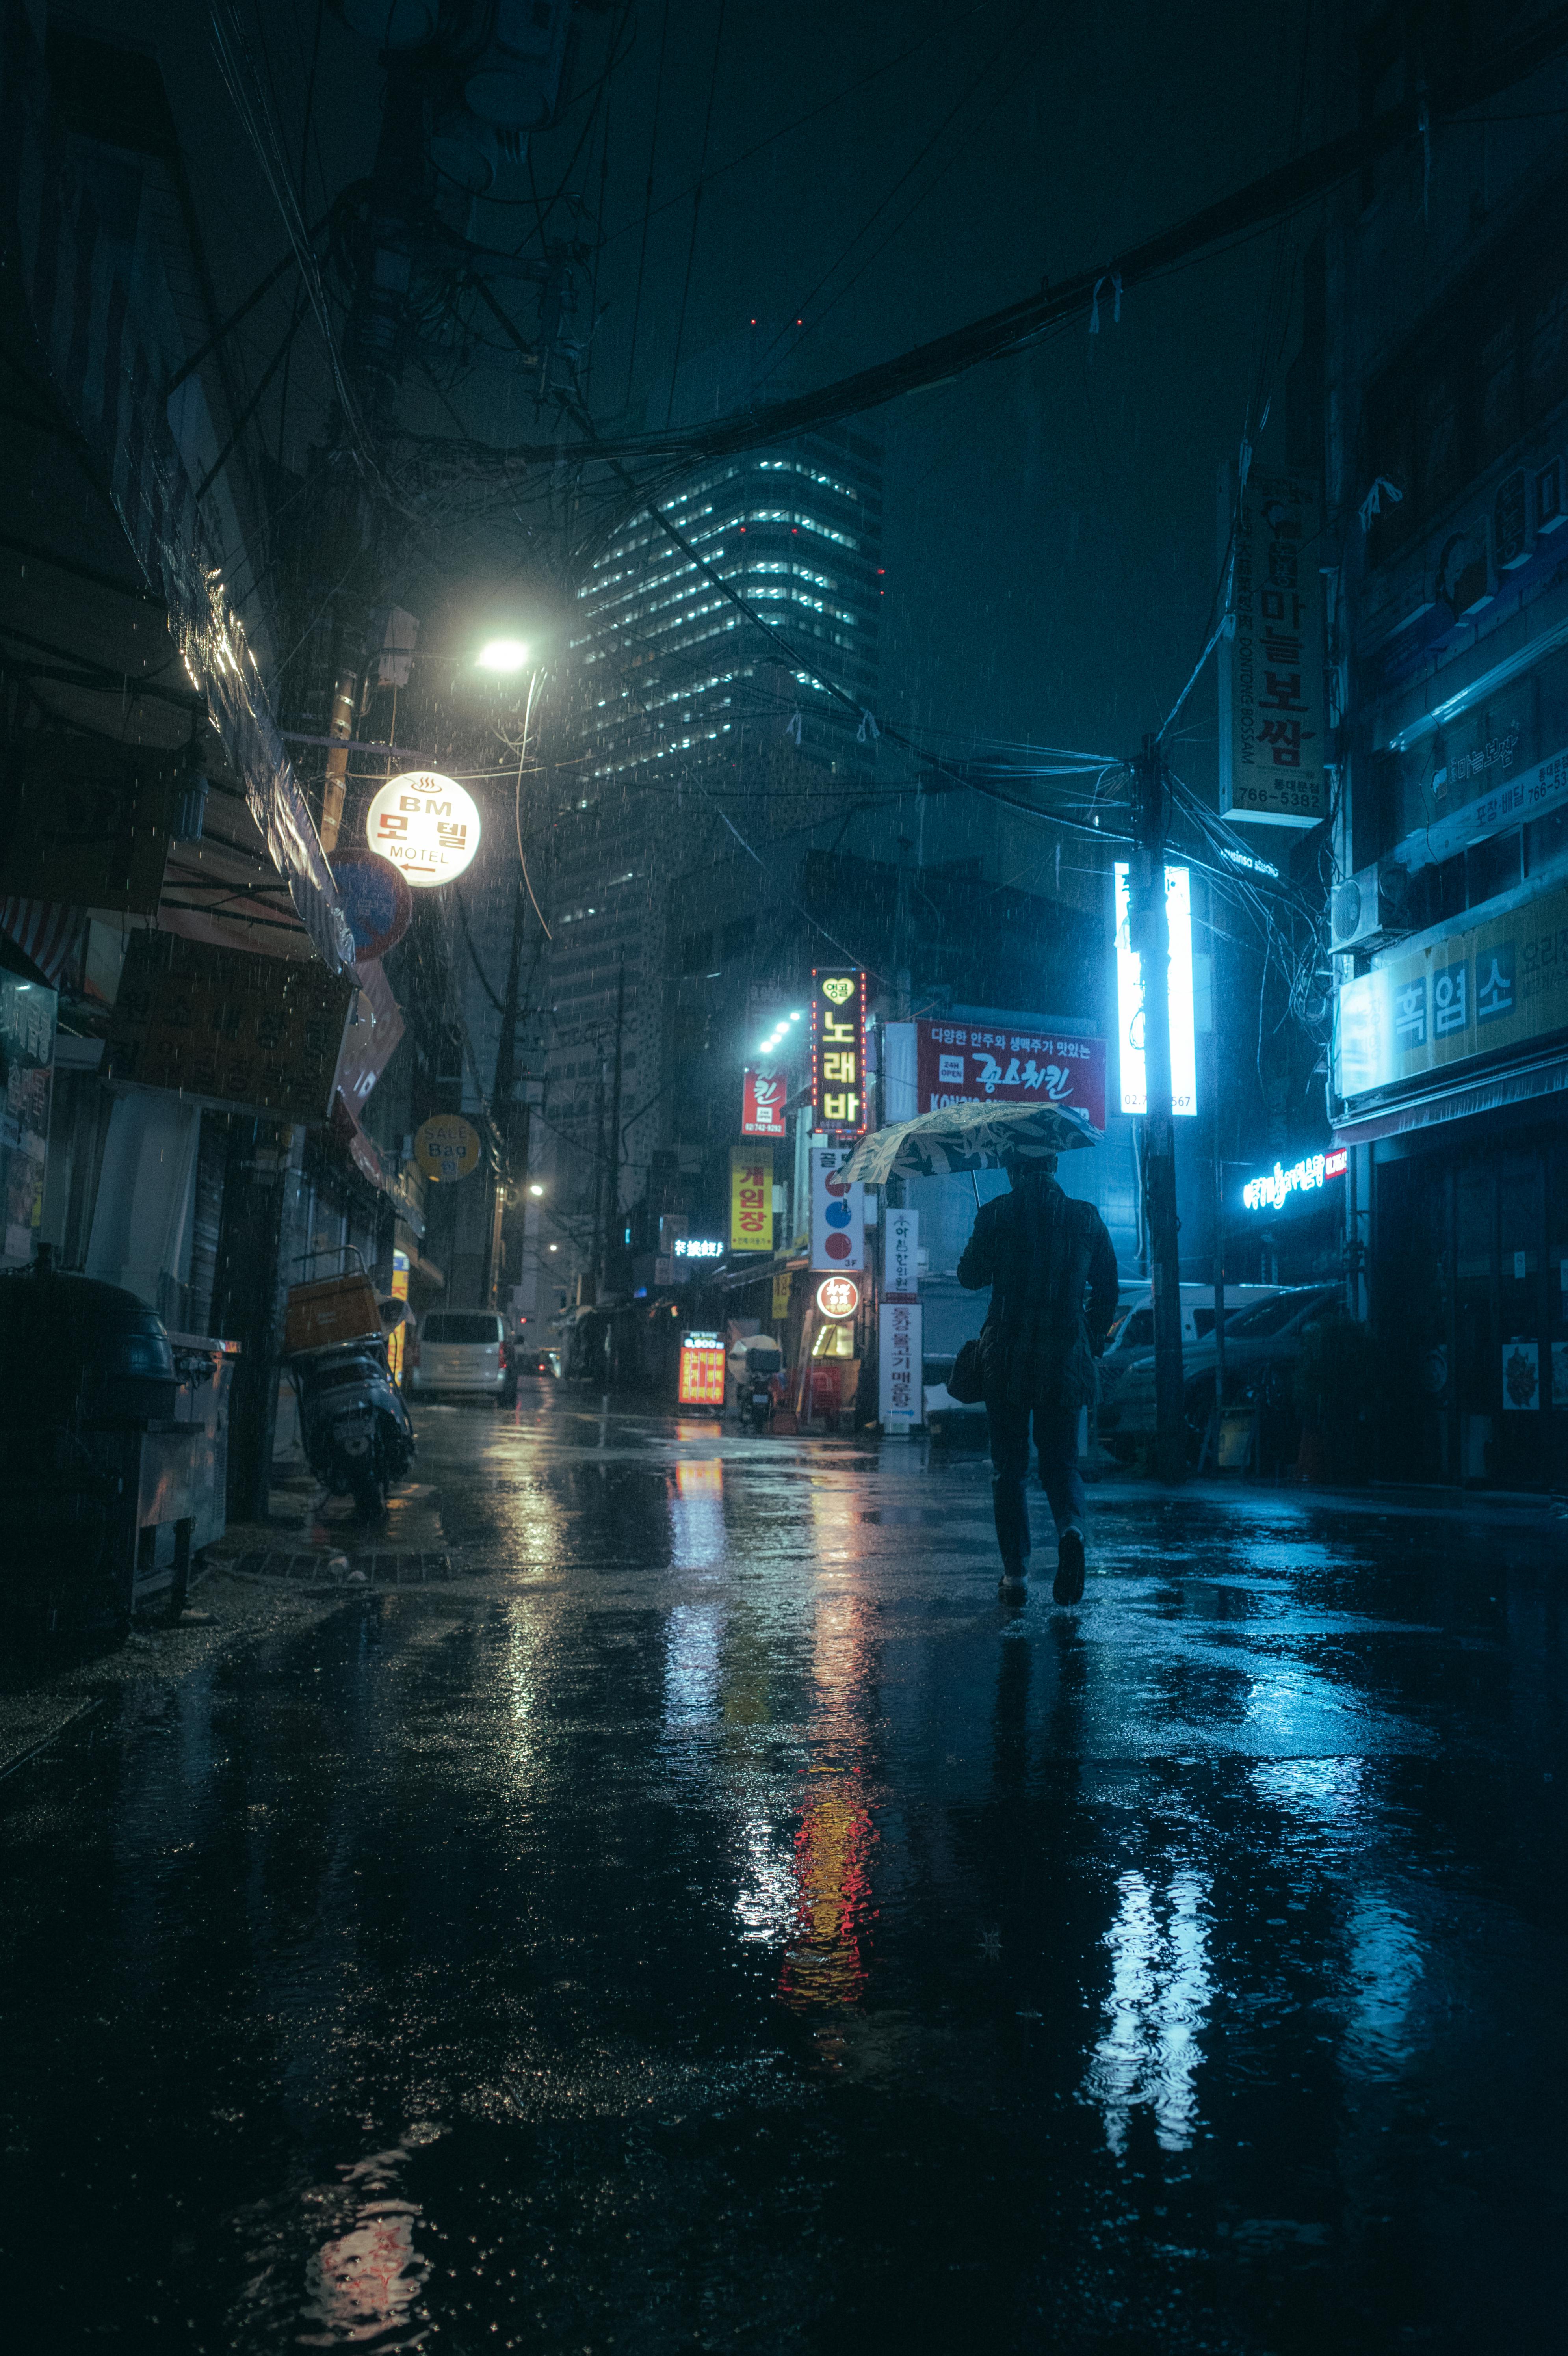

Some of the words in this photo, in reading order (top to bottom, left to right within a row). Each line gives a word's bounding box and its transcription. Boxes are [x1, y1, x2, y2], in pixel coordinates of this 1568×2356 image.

[1239, 638, 1254, 705] DONTONG
[1257, 590, 1315, 768] 마늘보쌈
[1239, 708, 1254, 765] BOSSAM
[399, 796, 451, 817] BM
[1239, 787, 1320, 808] 766-5382
[377, 814, 467, 850] 모텔
[390, 846, 449, 864] MOTEL
[826, 983, 848, 998] 앵콜
[1396, 958, 1512, 1040] 흑염소
[931, 1028, 967, 1046] 다양한
[970, 1032, 1006, 1049] 안주와
[1010, 1036, 1053, 1055] 생맥주가
[1057, 1041, 1091, 1060] 맛있는
[941, 1069, 962, 1078] OPEN
[944, 1061, 959, 1070] 24H
[424, 1126, 467, 1140] SALE
[429, 1143, 466, 1158] Bag
[739, 1166, 767, 1232] 게임장
